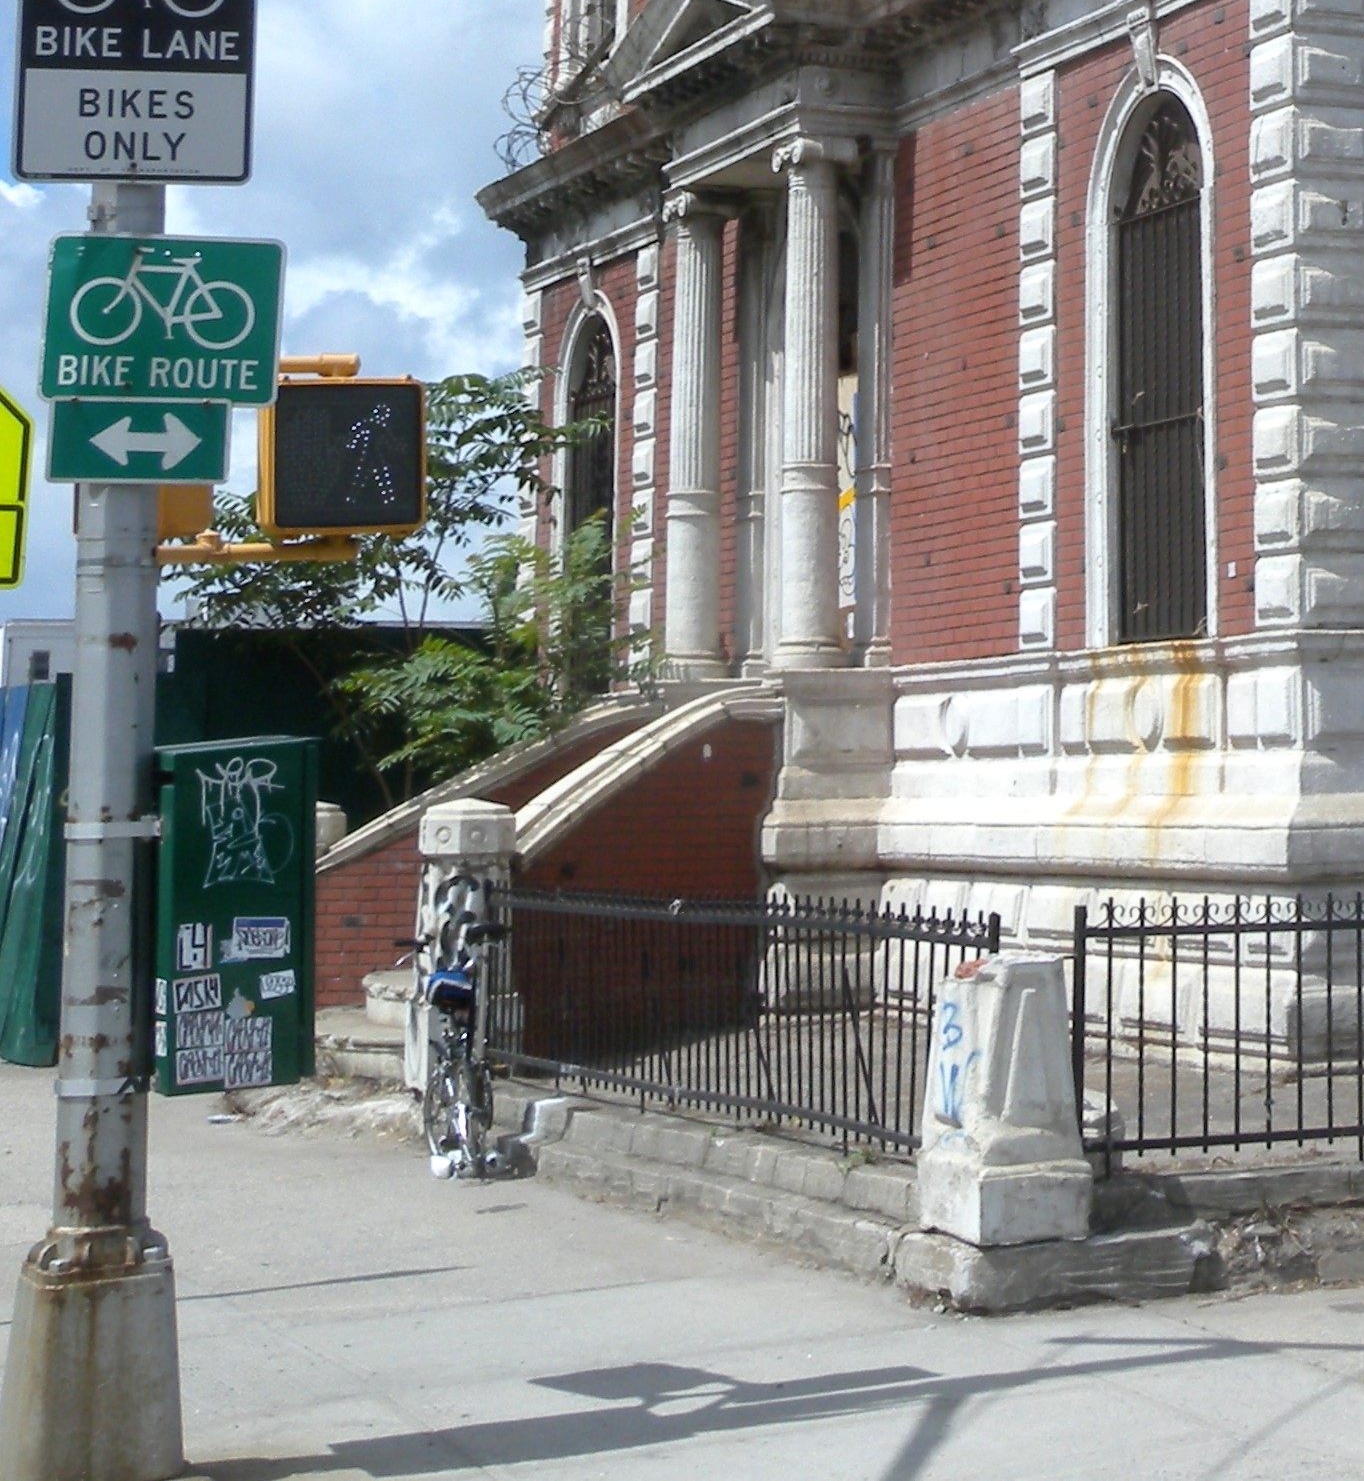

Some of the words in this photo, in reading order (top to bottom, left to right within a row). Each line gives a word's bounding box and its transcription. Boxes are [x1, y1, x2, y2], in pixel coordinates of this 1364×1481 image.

[35, 25, 122, 59] BIKE
[142, 30, 240, 61] LANE
[79, 88, 195, 120] BIKES
[84, 130, 187, 161] ONLY
[57, 356, 134, 386] BIKE
[149, 358, 259, 390] ROUTE
